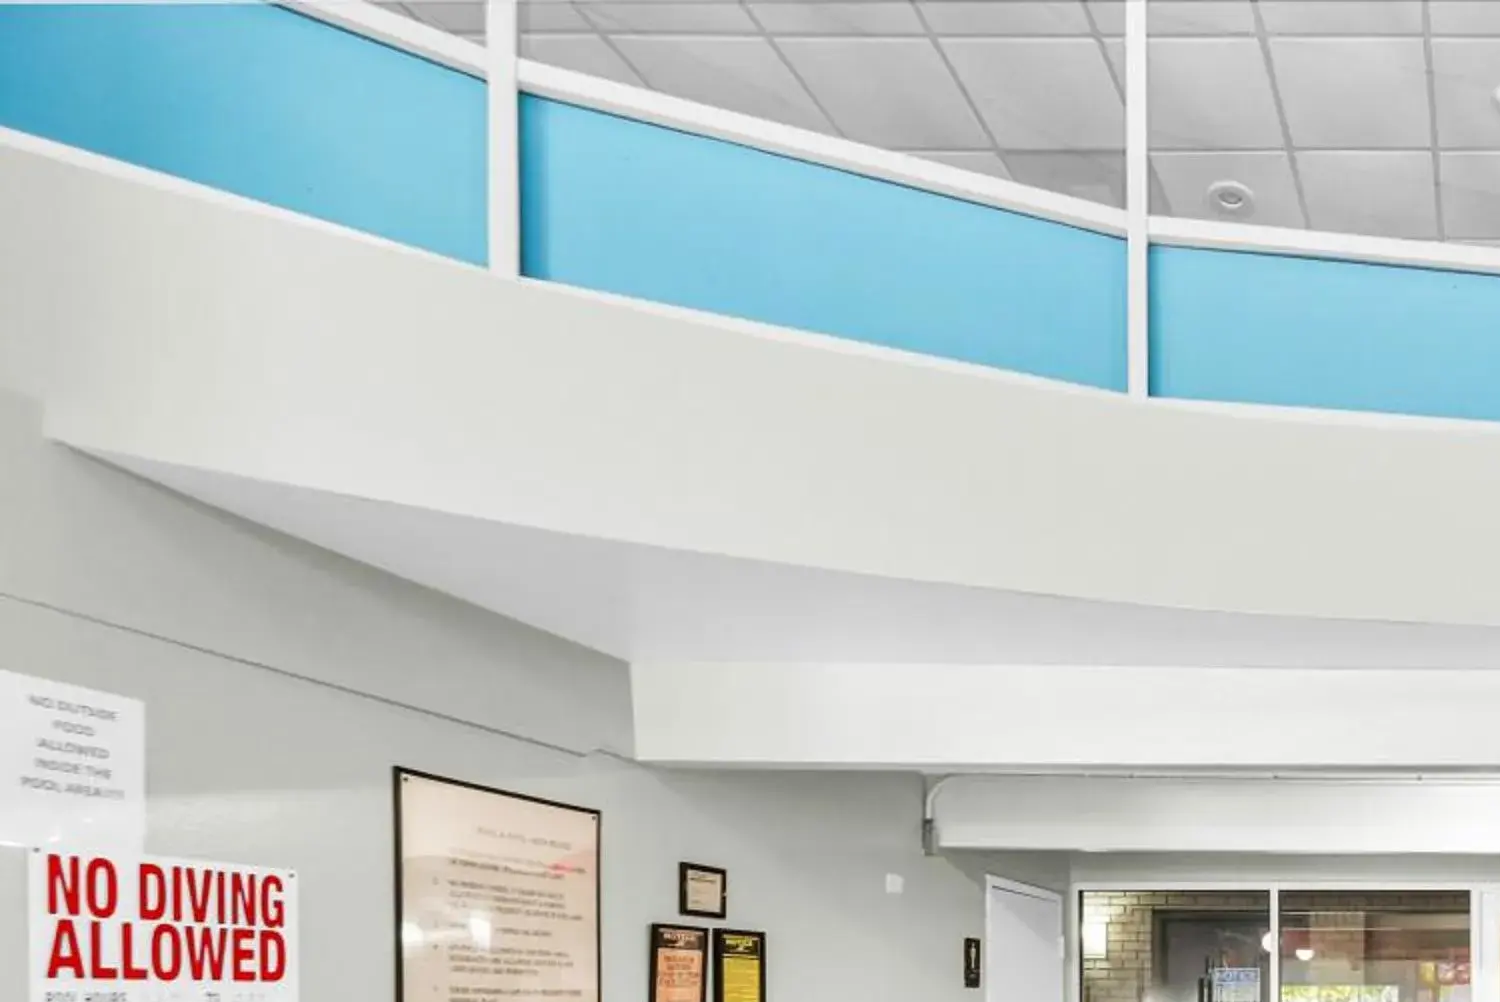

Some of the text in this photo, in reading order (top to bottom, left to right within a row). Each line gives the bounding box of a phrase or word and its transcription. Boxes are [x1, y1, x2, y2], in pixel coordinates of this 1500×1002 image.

[36, 738, 110, 759] ALLOWED
[47, 854, 285, 928] NO DIVING
[46, 919, 286, 982] ALLOWED
